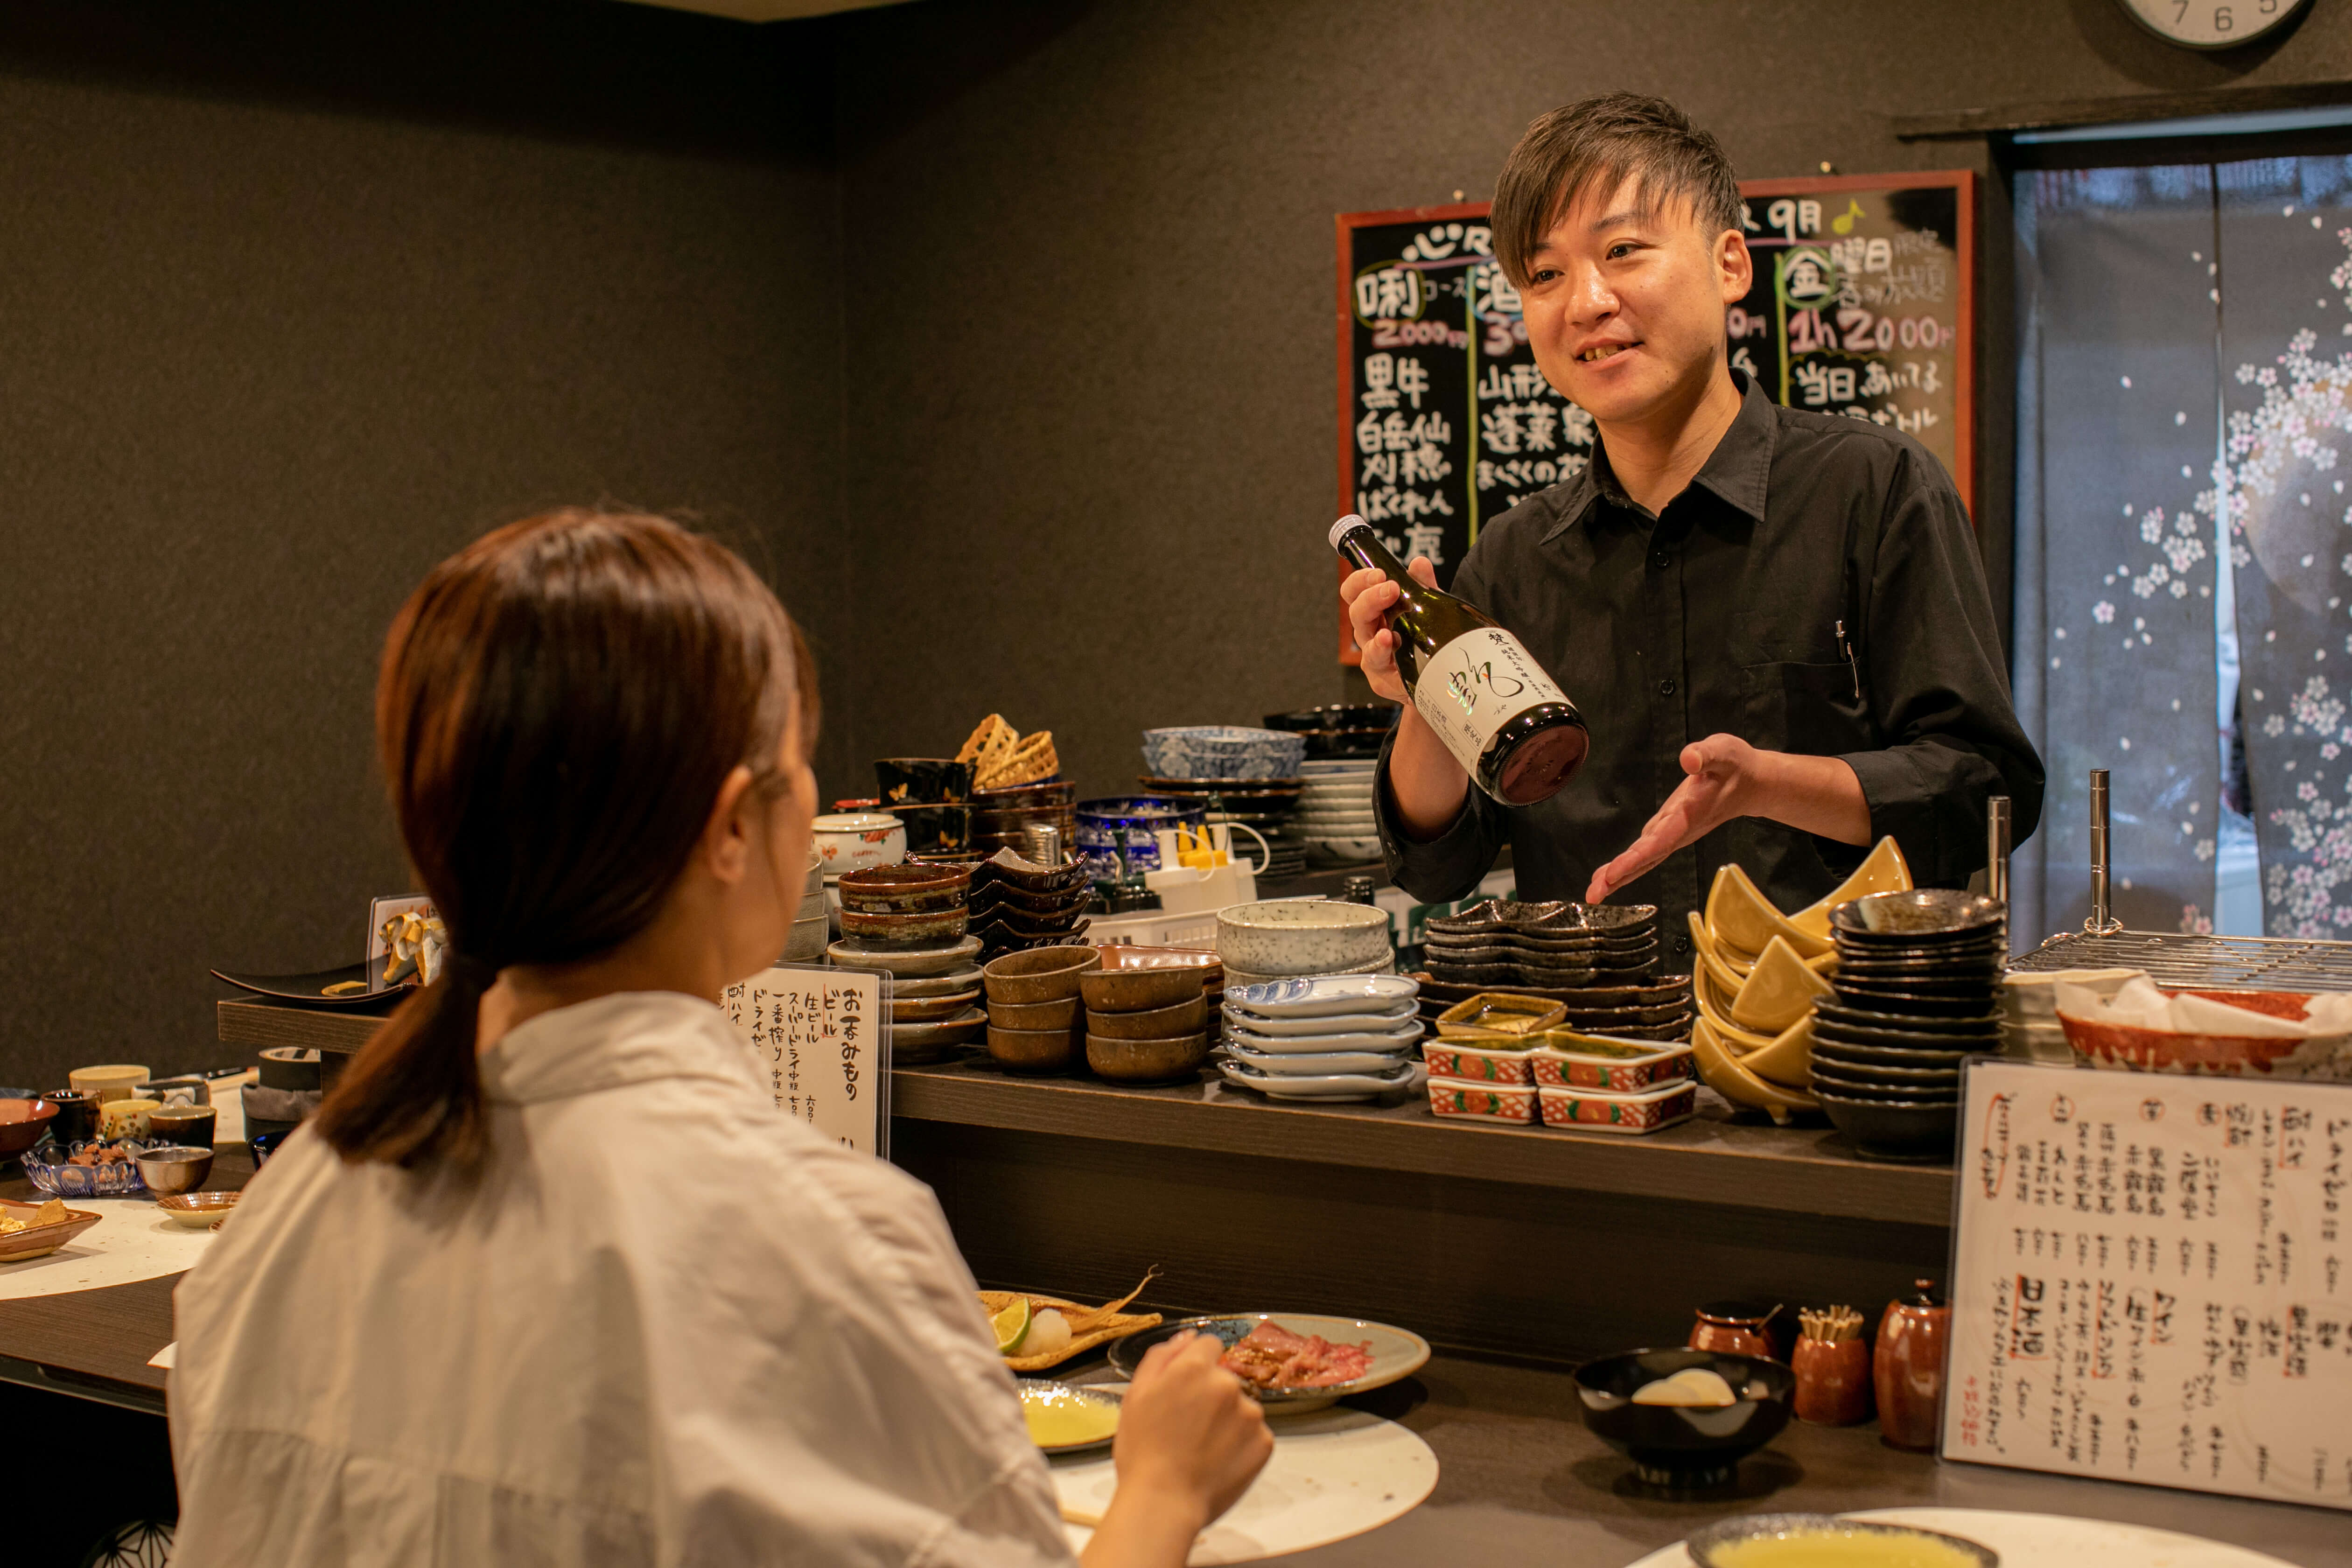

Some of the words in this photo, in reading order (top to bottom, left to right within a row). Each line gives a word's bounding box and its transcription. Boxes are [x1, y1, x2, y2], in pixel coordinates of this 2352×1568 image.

[2172, 0, 2190, 25] 7
[2214, 7, 2233, 32] 6
[1360, 352, 1430, 409] 黒牛
[1356, 410, 1451, 454] 白岳仙
[1357, 485, 1455, 524] ばくれん
[804, 992, 821, 1043] 生ビール
[824, 989, 840, 1036] ビール
[840, 988, 863, 1101] お呑みもの
